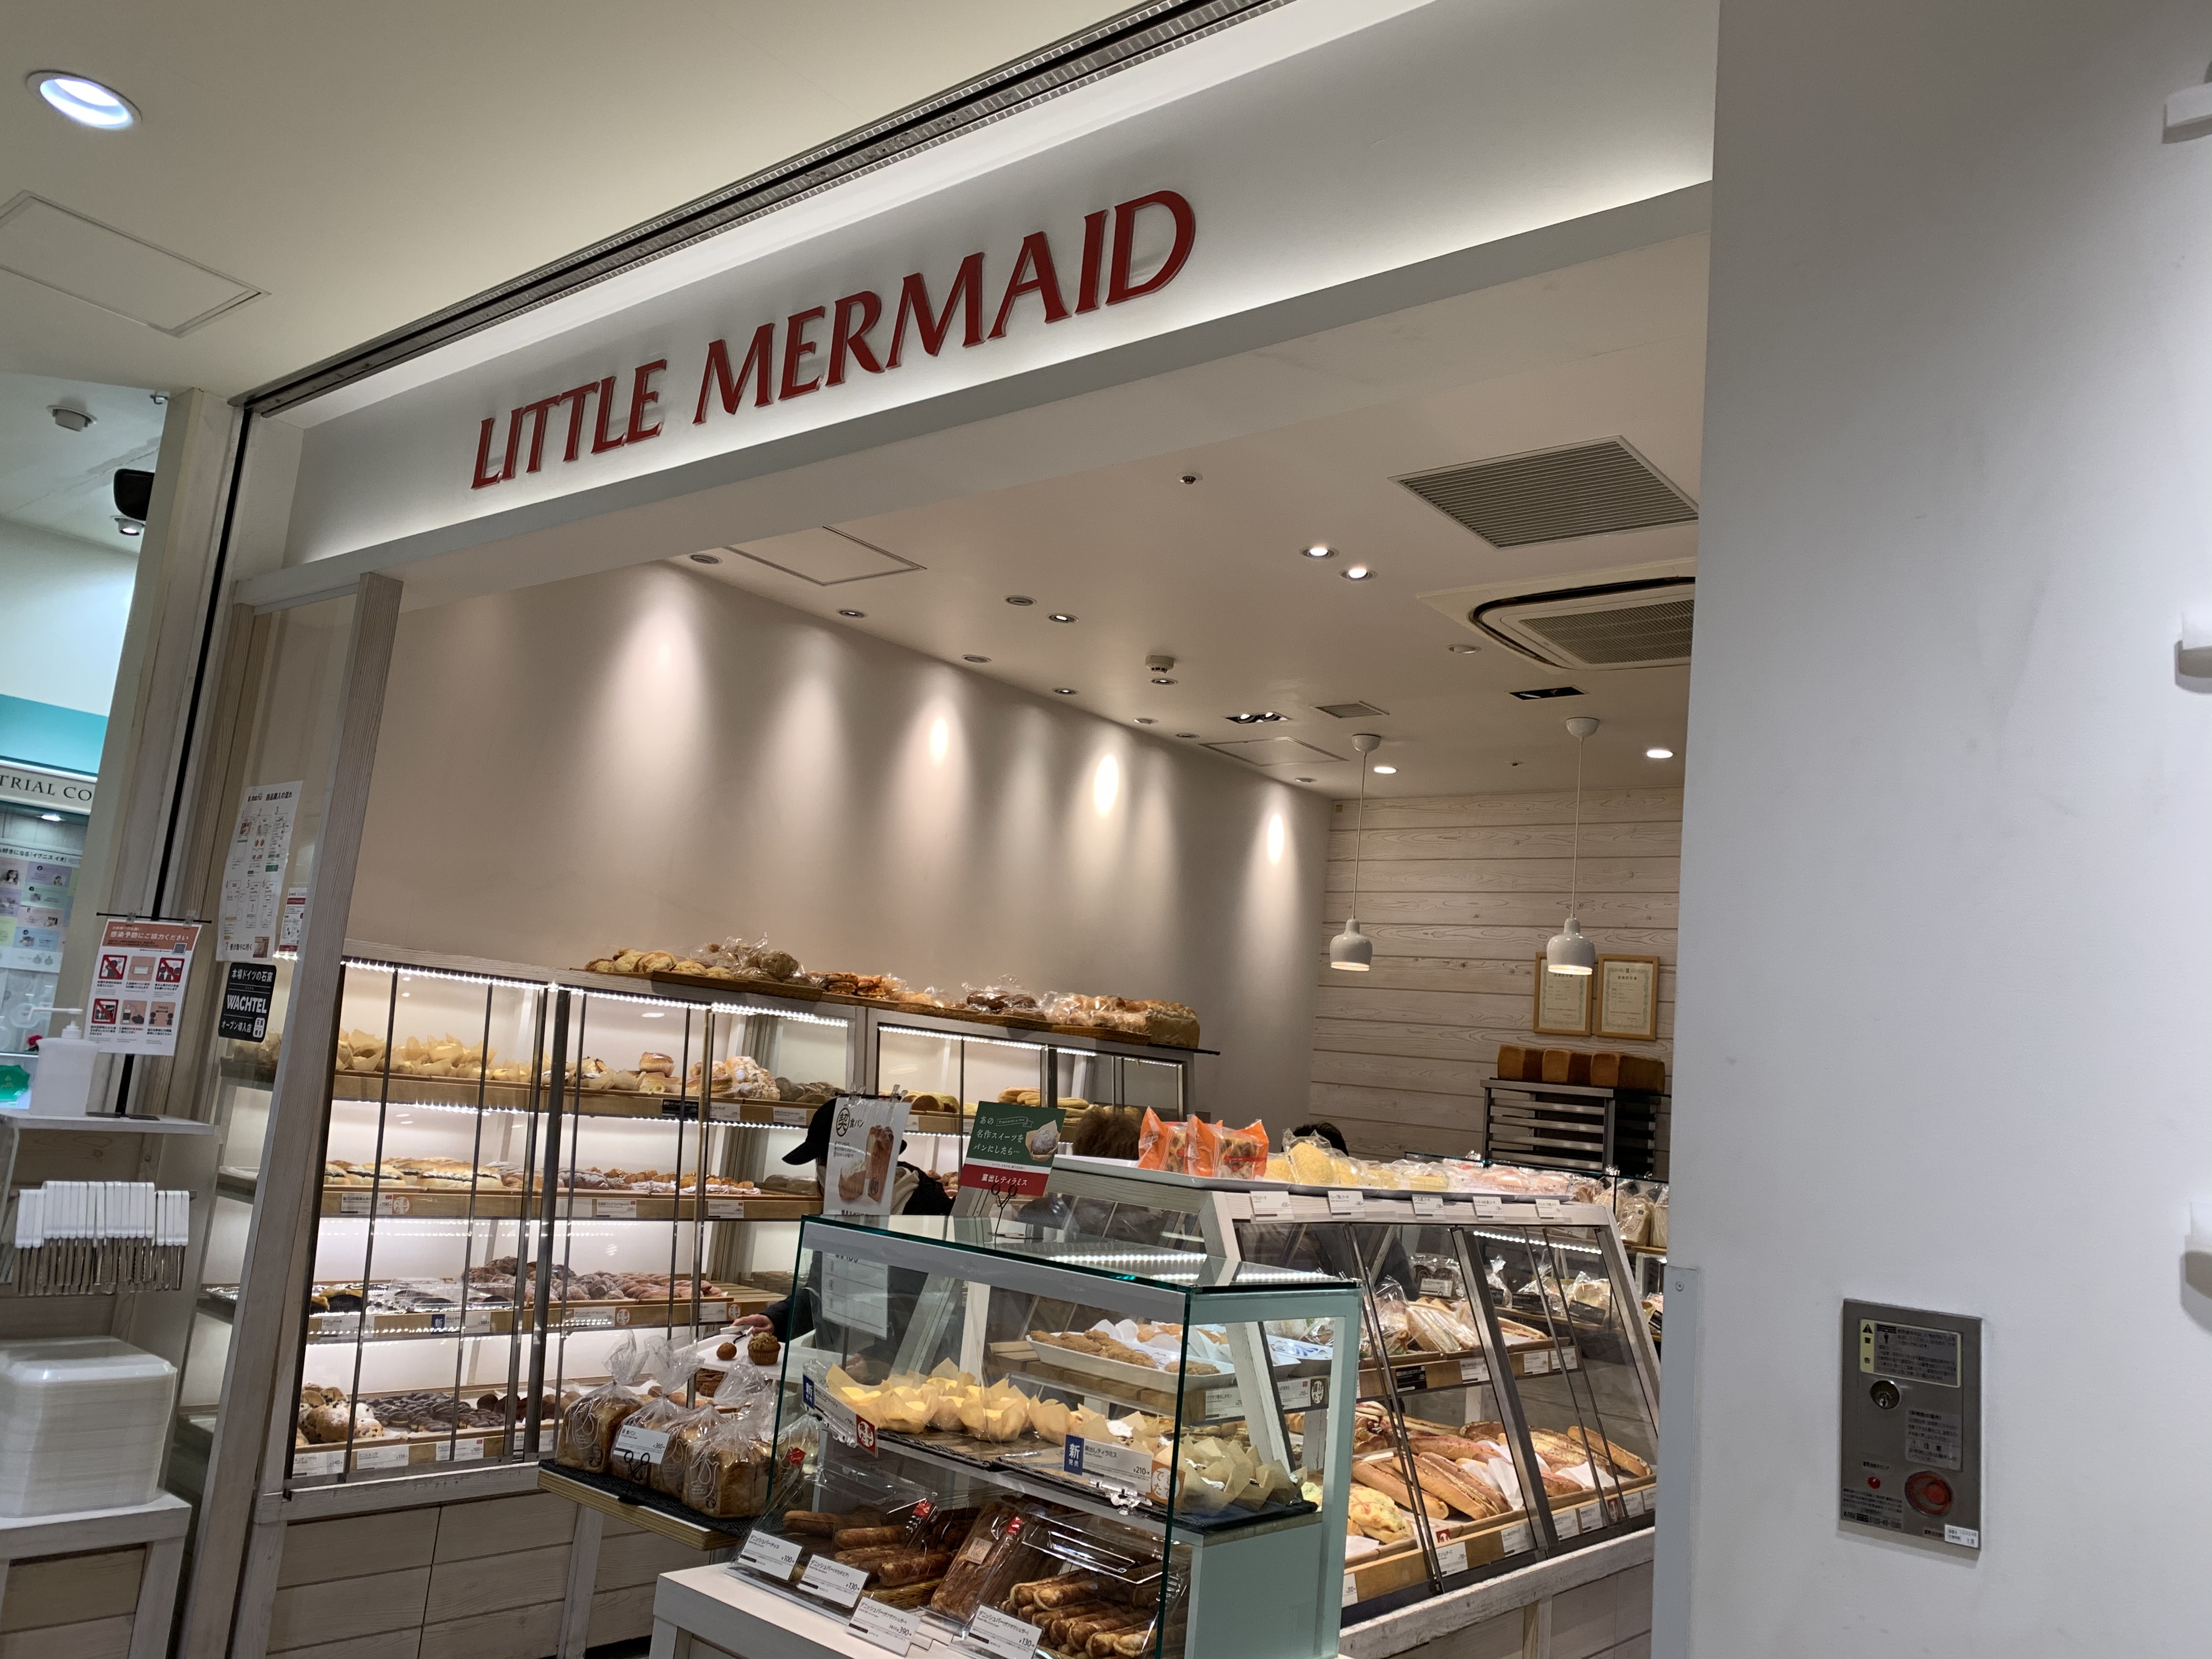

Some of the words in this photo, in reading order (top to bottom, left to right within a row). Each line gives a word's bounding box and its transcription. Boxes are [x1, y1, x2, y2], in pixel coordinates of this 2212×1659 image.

[471, 358, 667, 489] LITTLE
[692, 189, 1196, 426] MERMAID
[0, 775, 55, 796] TRIAL
[110, 931, 188, 941] 感染予防にご協力ください
[232, 969, 273, 983] 本場ドイツの石窯
[227, 994, 267, 1014] WACHTEL
[980, 1115, 994, 1125] あの
[977, 1128, 1024, 1143] 名作スイーツを
[981, 1173, 1028, 1186] 窯出しティラミス
[806, 1383, 812, 1397] 新
[1069, 1443, 1080, 1460] 新
[1068, 1458, 1079, 1467] 発売
